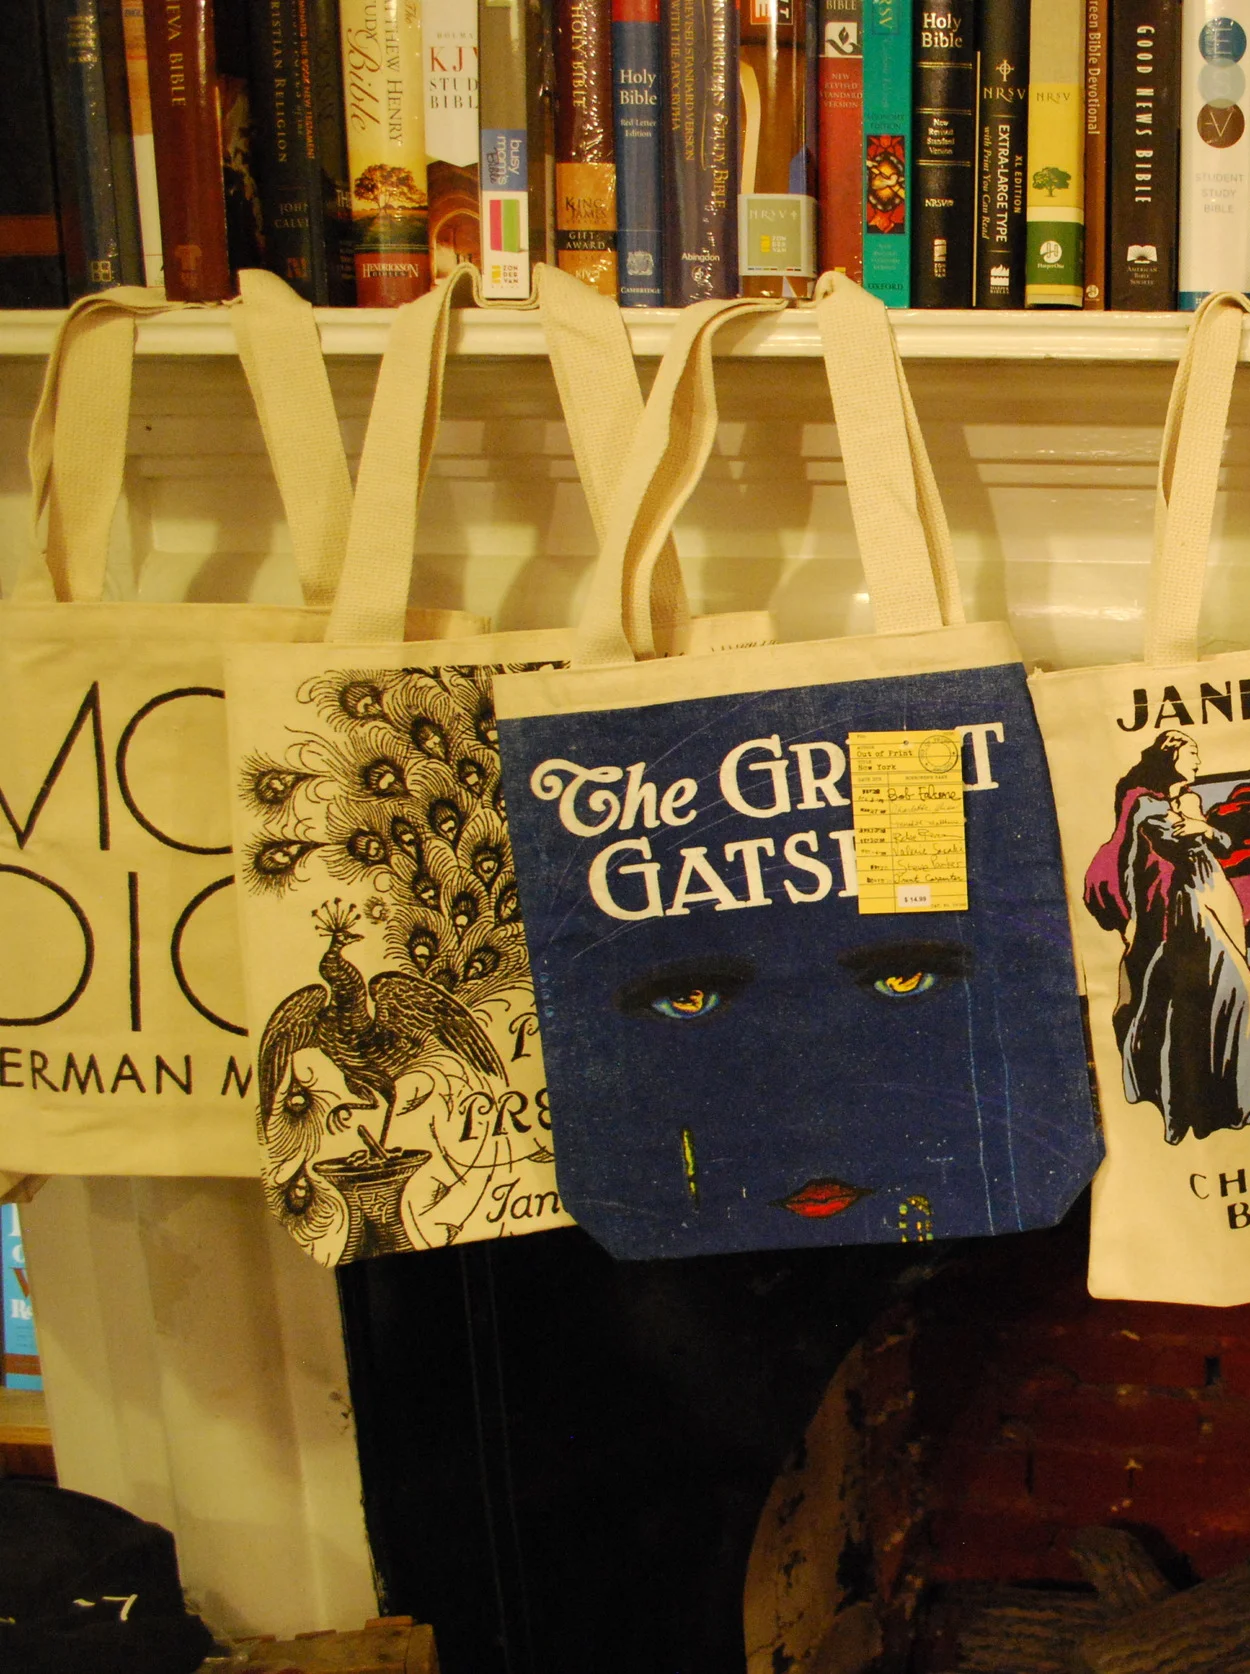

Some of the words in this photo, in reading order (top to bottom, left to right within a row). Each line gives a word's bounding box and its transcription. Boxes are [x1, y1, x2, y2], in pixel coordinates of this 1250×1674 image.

[826, 0, 857, 10] BIBLE
[571, 4, 584, 57] HOLY
[923, 13, 962, 32] Holy
[671, 32, 681, 58] THE
[922, 31, 963, 48] Bible
[1088, 32, 1101, 64] Bible
[1136, 25, 1155, 74] GOOD
[168, 53, 186, 107] BIBLE
[347, 28, 384, 132] Bible
[571, 61, 588, 109] BIBLE
[620, 69, 657, 88] Holy
[685, 47, 694, 111] STANDARD
[620, 91, 658, 106] Bible
[671, 61, 681, 132] APOCRYPHA
[983, 87, 1026, 102] NRSV
[1036, 91, 1071, 102] NRSV
[1087, 67, 1101, 135] Devotional
[275, 78, 288, 163] RELIGION
[386, 80, 404, 146] HENRY
[620, 119, 636, 127] Red
[638, 119, 657, 128] Letter
[1135, 88, 1154, 136] NEWS
[305, 111, 315, 159] TESTAMENT
[624, 129, 652, 138] Edition
[685, 114, 695, 161] VERSION
[713, 113, 728, 164] STUDY
[984, 126, 993, 146] with
[497, 136, 507, 186] mom's
[510, 139, 522, 176] busy
[984, 147, 993, 169] Print
[996, 124, 1010, 210] EXTRA-LARGE
[1014, 155, 1022, 167] XL
[713, 168, 729, 209] BIBLE
[983, 171, 992, 190] You
[1134, 149, 1154, 203] BIBLE
[1194, 173, 1245, 182] STUDENT
[982, 190, 991, 210] Can
[1014, 171, 1023, 214] EDITION
[1201, 188, 1237, 198] STUDY
[1203, 204, 1235, 213] BIBLE
[981, 212, 990, 240] Read
[996, 211, 1008, 243] TYPE
[566, 241, 606, 249] AWARD
[681, 252, 720, 262] Abingdon
[620, 286, 661, 295] CAMBRIDGE
[857, 750, 873, 758] Out
[875, 749, 885, 757] of
[888, 749, 913, 757] Print
[877, 763, 897, 771] York
[529, 757, 699, 838] The
[887, 787, 914, 802] Bob
